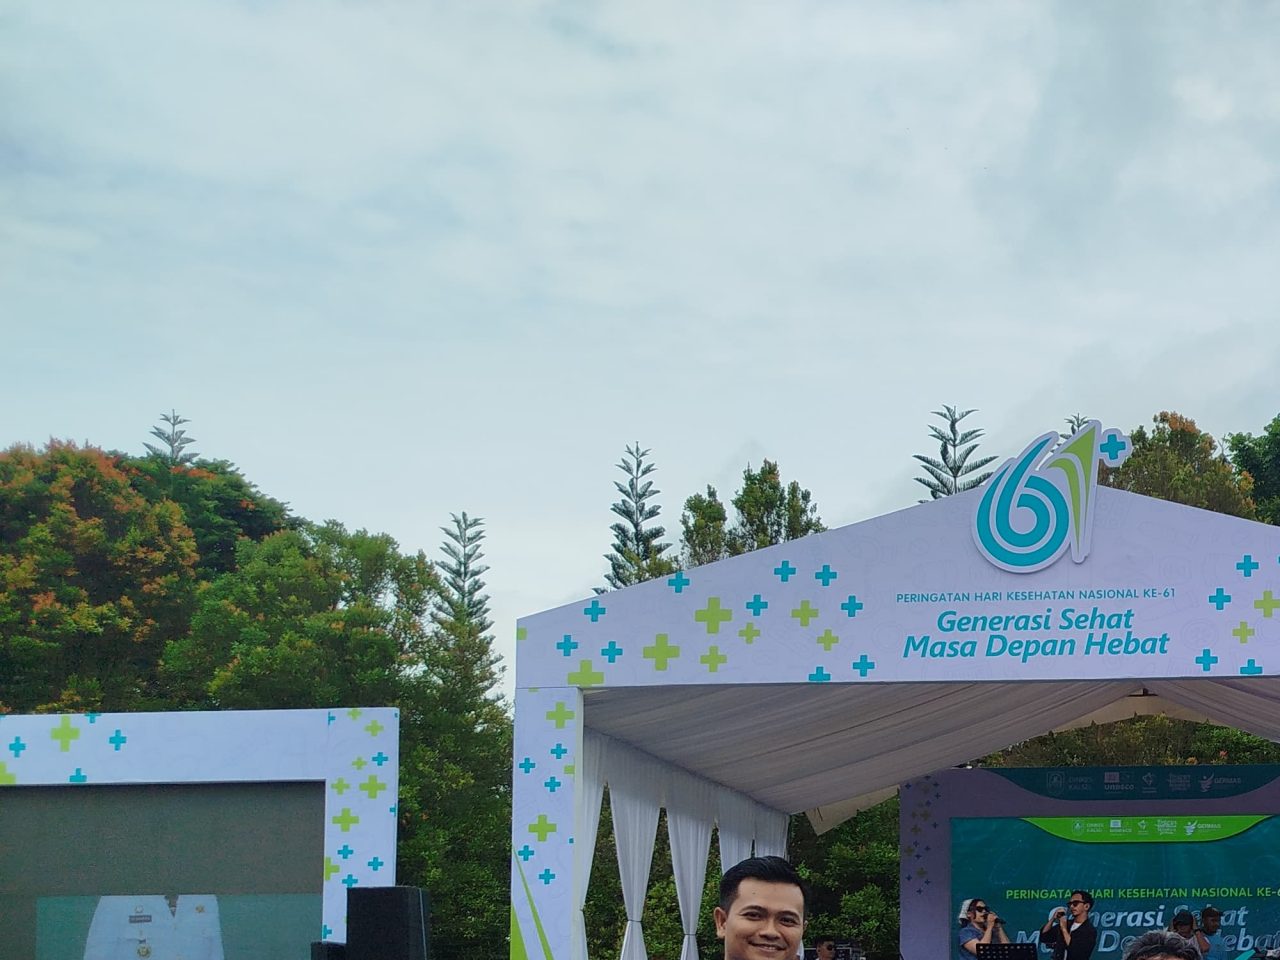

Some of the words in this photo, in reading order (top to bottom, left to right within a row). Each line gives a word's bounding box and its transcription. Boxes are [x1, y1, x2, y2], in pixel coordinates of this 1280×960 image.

[896, 592, 970, 603] PERINGATAN
[974, 591, 1002, 602] HARI
[1006, 590, 1077, 602] KESEHATAN
[1079, 588, 1139, 600] NASIONAL
[1143, 587, 1176, 599] KE-61
[937, 608, 1053, 633] Generasi
[1058, 607, 1135, 631] Sehat
[902, 635, 978, 659] Masa
[985, 633, 1077, 664] Depan
[1084, 630, 1171, 656] Hebat
[1006, 888, 1080, 900] PERINGATA
[1118, 887, 1188, 898] KESEHATAN
[1191, 887, 1252, 898] NASIONAL
